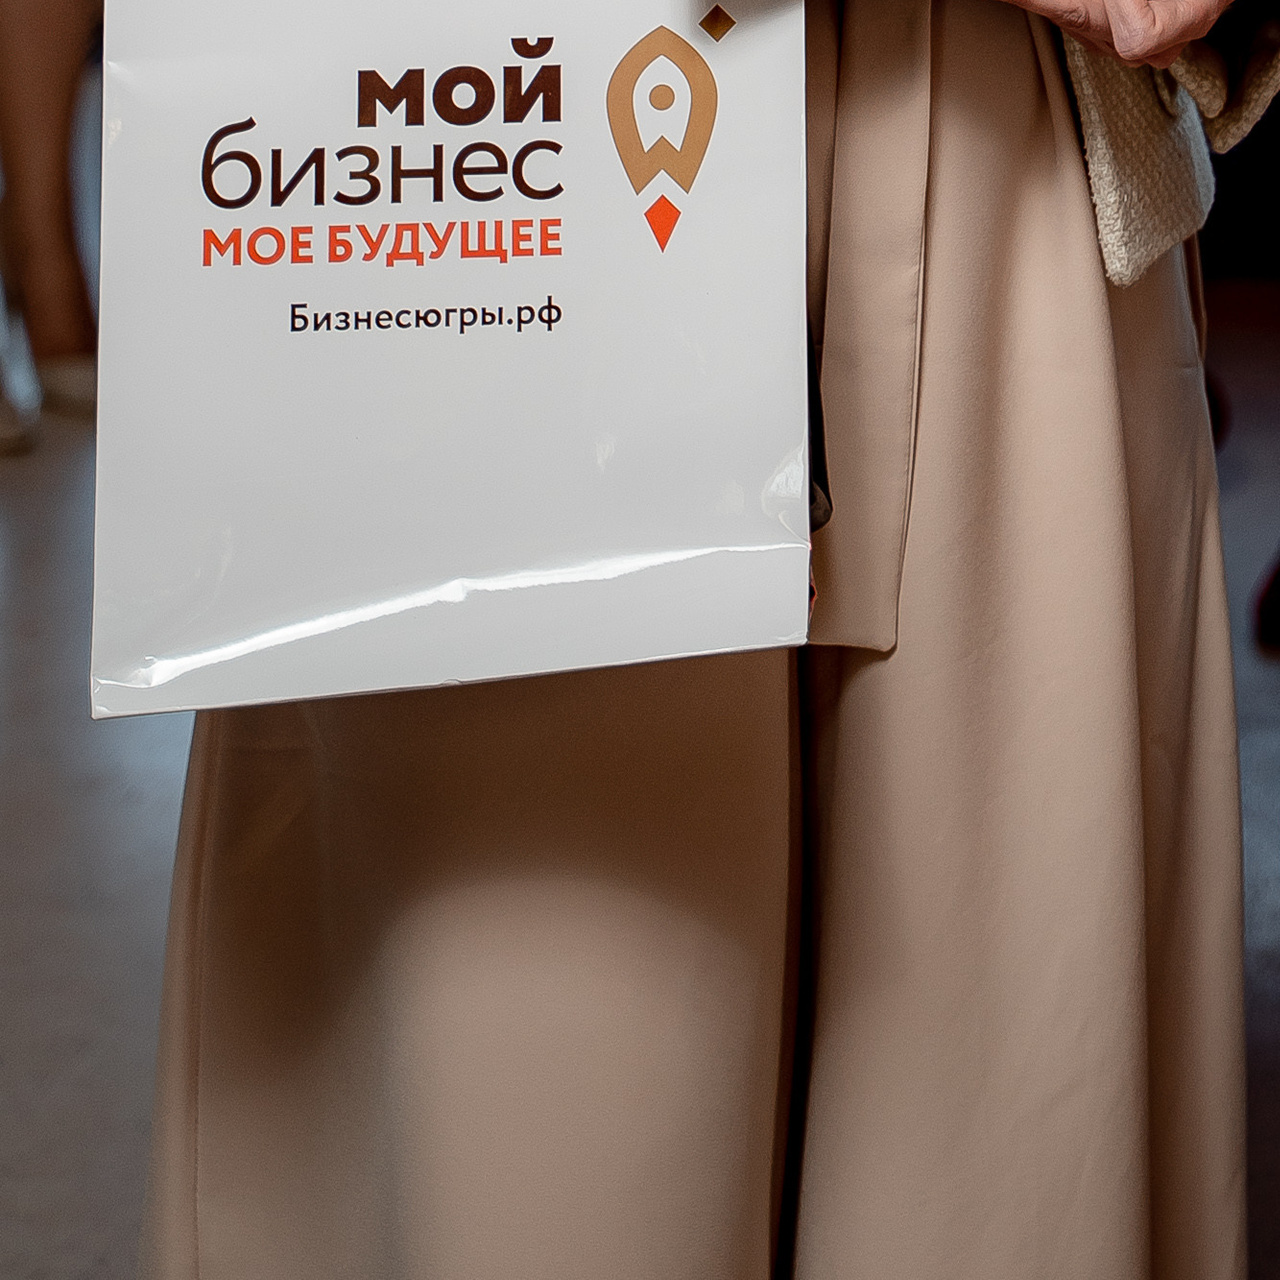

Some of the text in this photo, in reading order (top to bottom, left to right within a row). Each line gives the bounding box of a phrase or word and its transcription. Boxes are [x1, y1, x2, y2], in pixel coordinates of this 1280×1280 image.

[356, 36, 562, 128] мой
[200, 116, 564, 210] бизнес
[201, 218, 563, 269] МОЕ БУДУЩЕЕ
[289, 295, 562, 335] Бизнесюгры.рф
